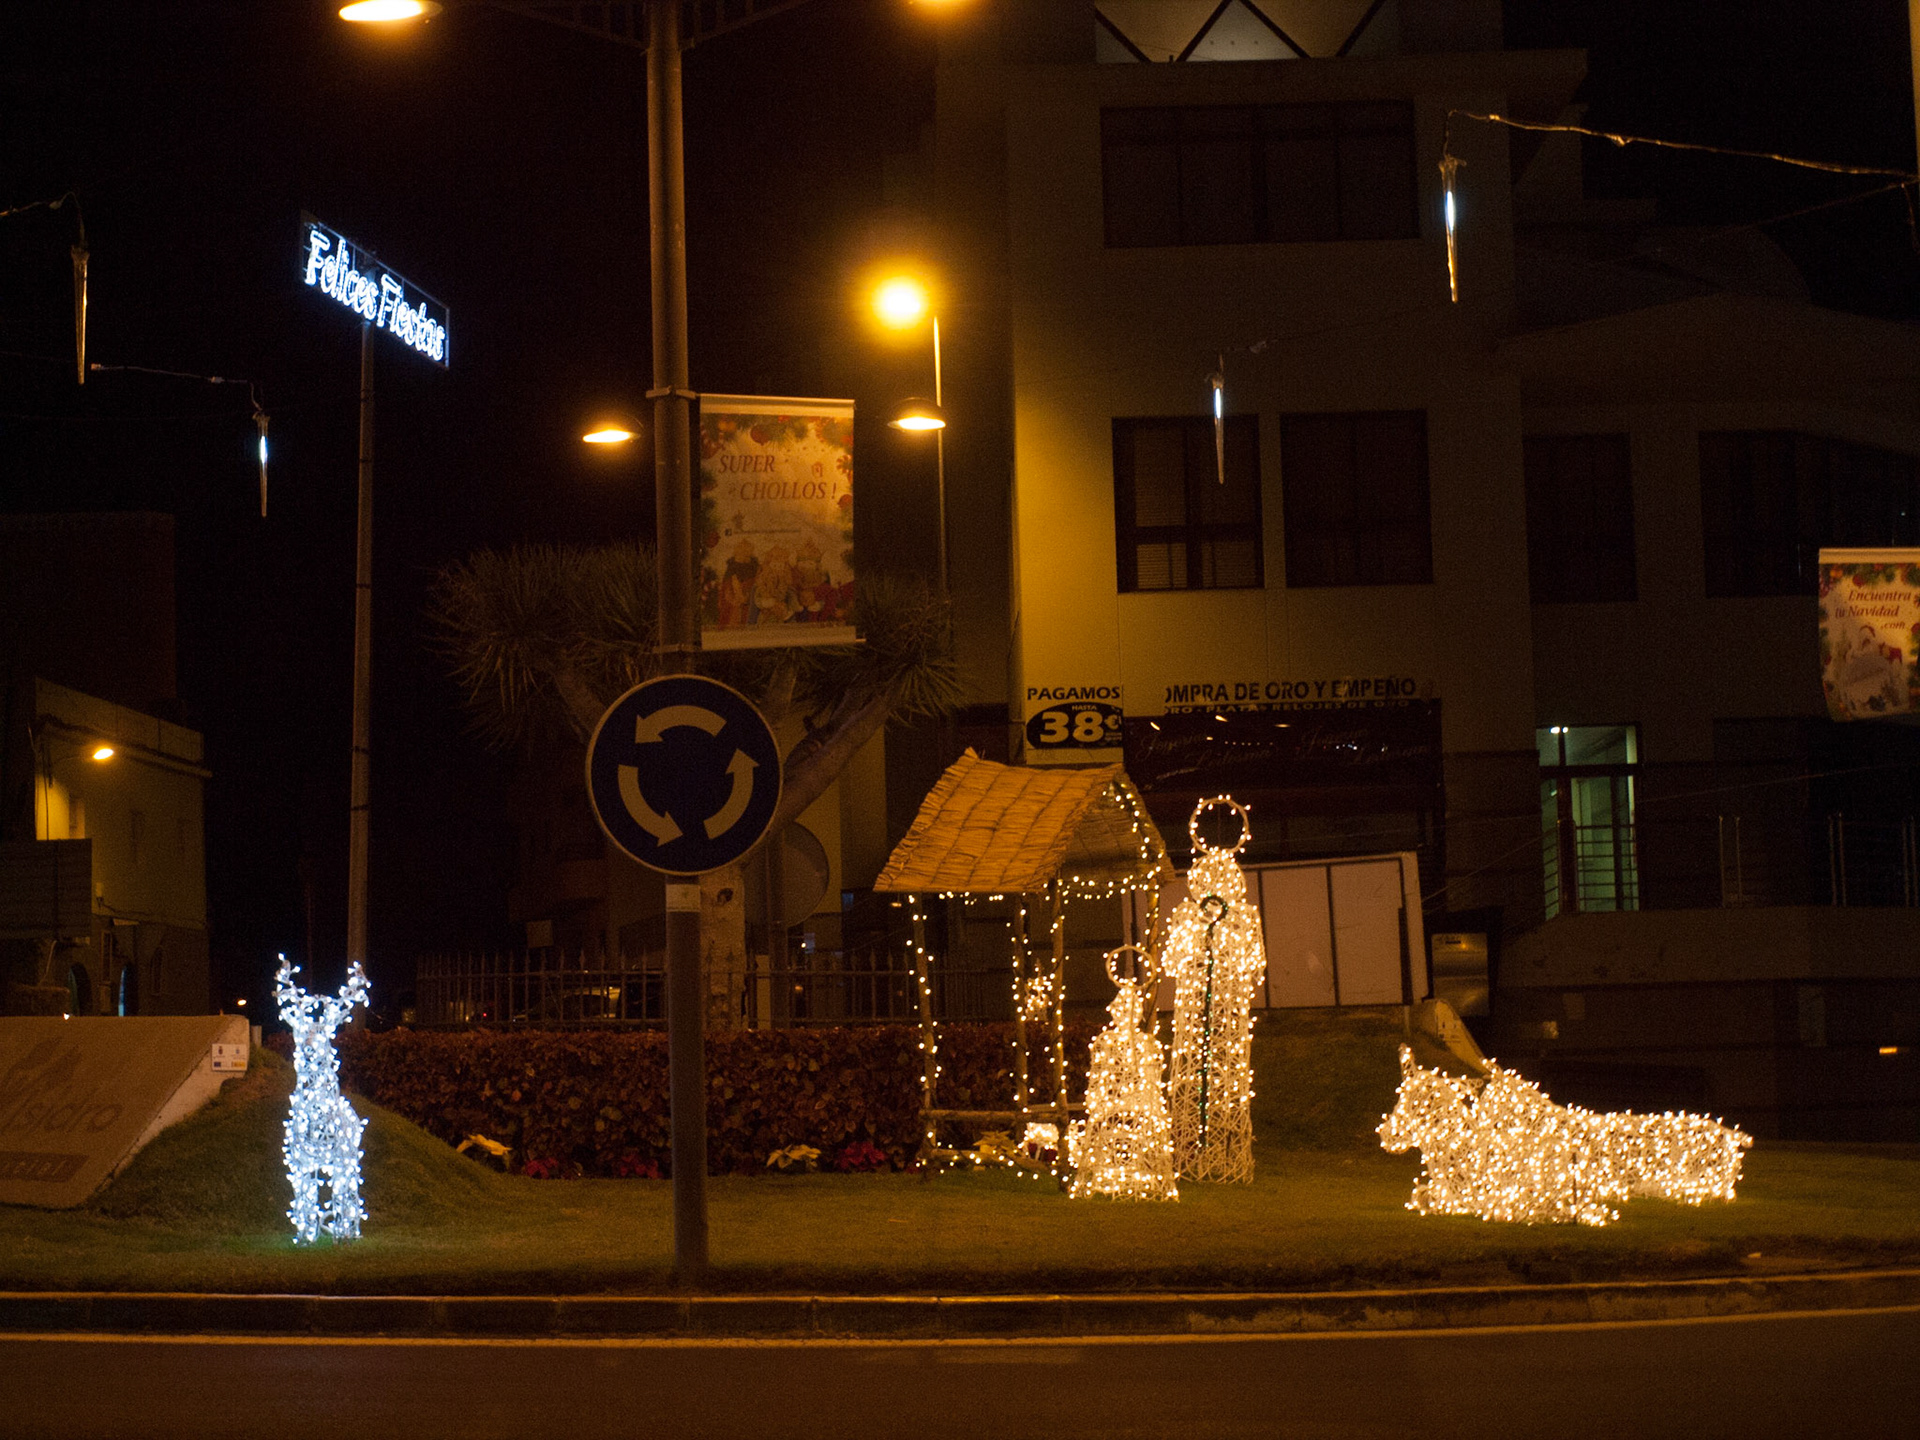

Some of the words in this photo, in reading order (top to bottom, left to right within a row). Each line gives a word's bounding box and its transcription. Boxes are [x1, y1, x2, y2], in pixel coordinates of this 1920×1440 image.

[304, 229, 379, 321] Felices
[376, 273, 446, 362] Fiestas
[717, 454, 775, 474] SUPER
[739, 481, 827, 500] CHOLLOS
[1849, 590, 1911, 601] Encuentra
[1849, 605, 1900, 616] Navidad
[1027, 686, 1121, 700] PAGAMOS
[1234, 682, 1260, 700] DE
[1265, 680, 1309, 699] ORO
[1313, 680, 1326, 698] Y
